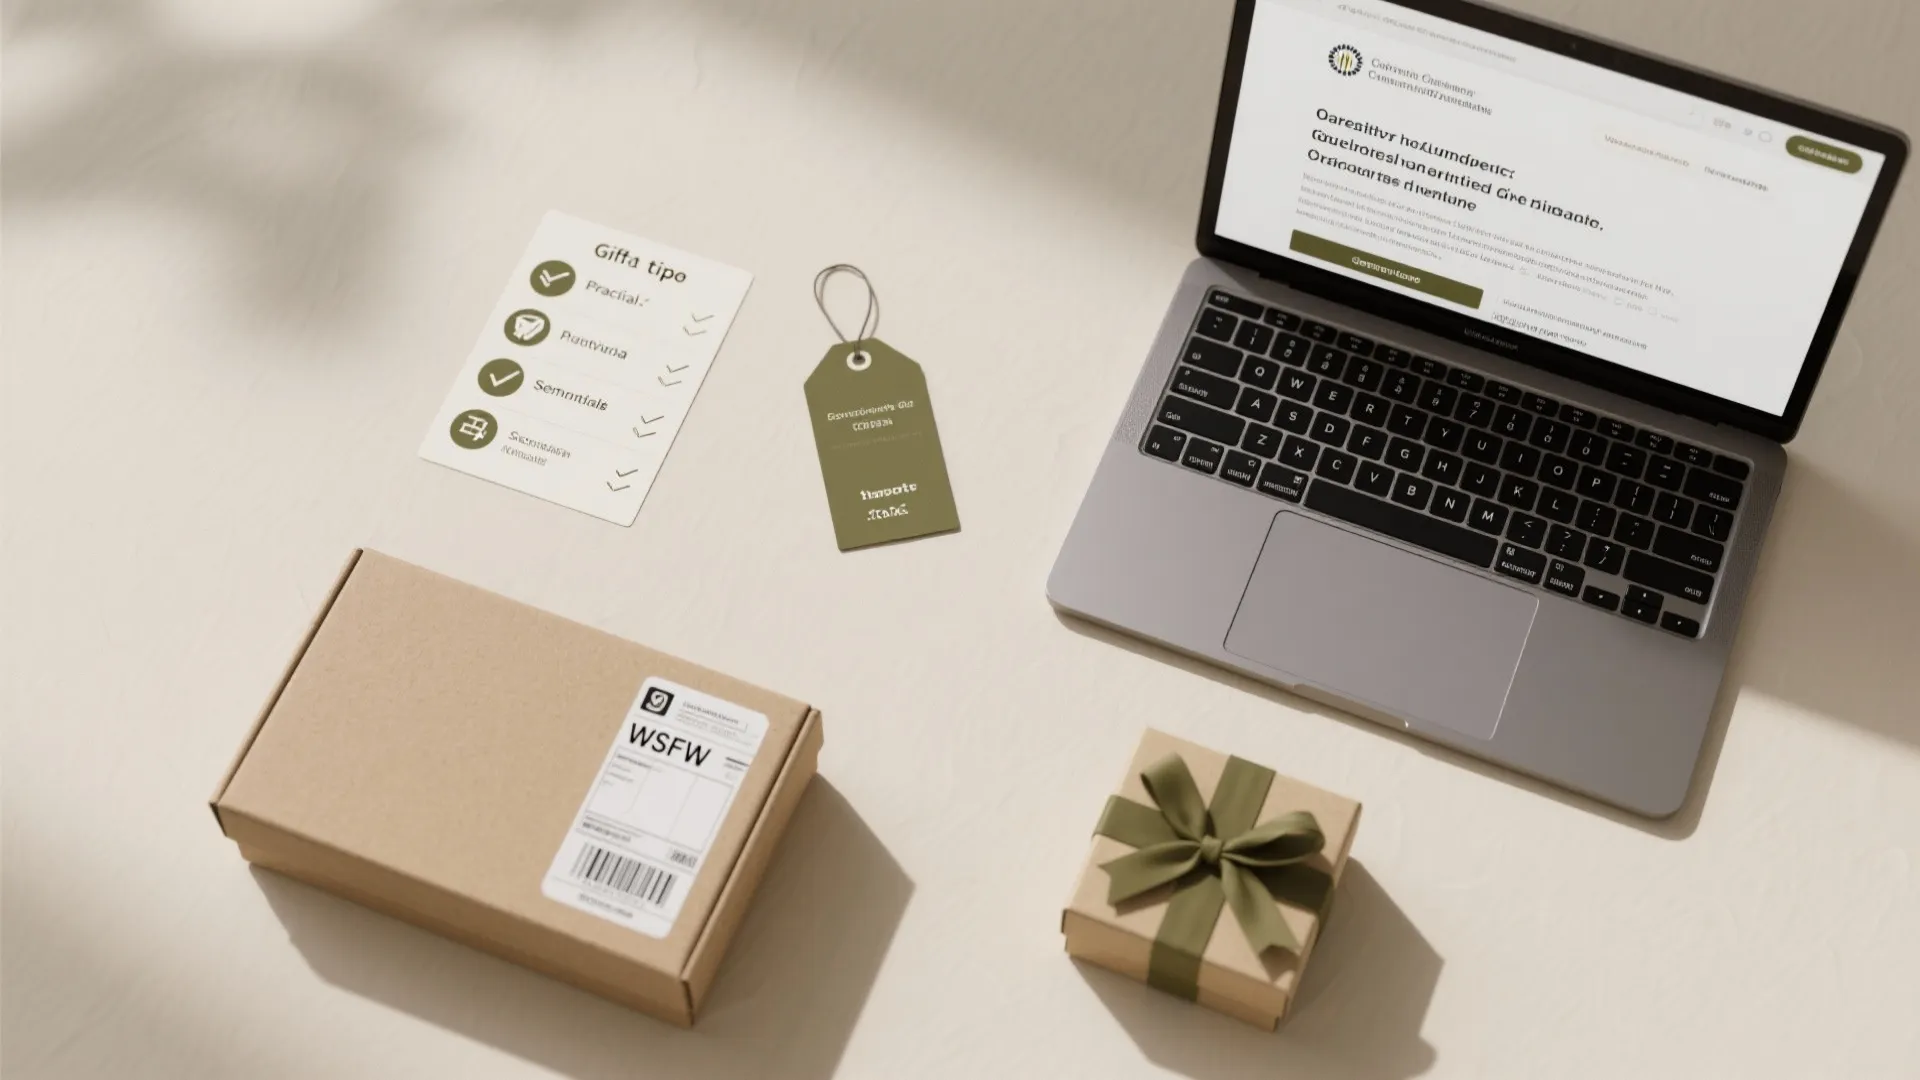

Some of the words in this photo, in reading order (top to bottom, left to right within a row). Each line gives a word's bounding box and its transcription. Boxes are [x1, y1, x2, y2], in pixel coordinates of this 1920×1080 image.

[1290, 377, 1305, 390] W
[1328, 390, 1338, 401] E
[1250, 397, 1261, 409] A
[1365, 403, 1375, 414] R
[1288, 411, 1298, 422] S
[1404, 414, 1413, 426] T
[1324, 422, 1335, 434] D
[1441, 427, 1450, 438] Y
[1256, 433, 1268, 446] Z
[1361, 435, 1372, 446] F
[1477, 439, 1487, 451] U
[1294, 445, 1305, 458] X
[1400, 448, 1410, 460] G
[1331, 459, 1342, 471] C
[1553, 465, 1564, 476] O
[1370, 471, 1380, 483] V
[1476, 474, 1485, 485] J
[1591, 477, 1601, 488] P
[1406, 484, 1417, 497] B
[1513, 485, 1524, 498] K
[1444, 496, 1456, 510] N
[1551, 499, 1561, 510] L
[1481, 510, 1495, 523] M
[629, 722, 712, 767] WSFW
